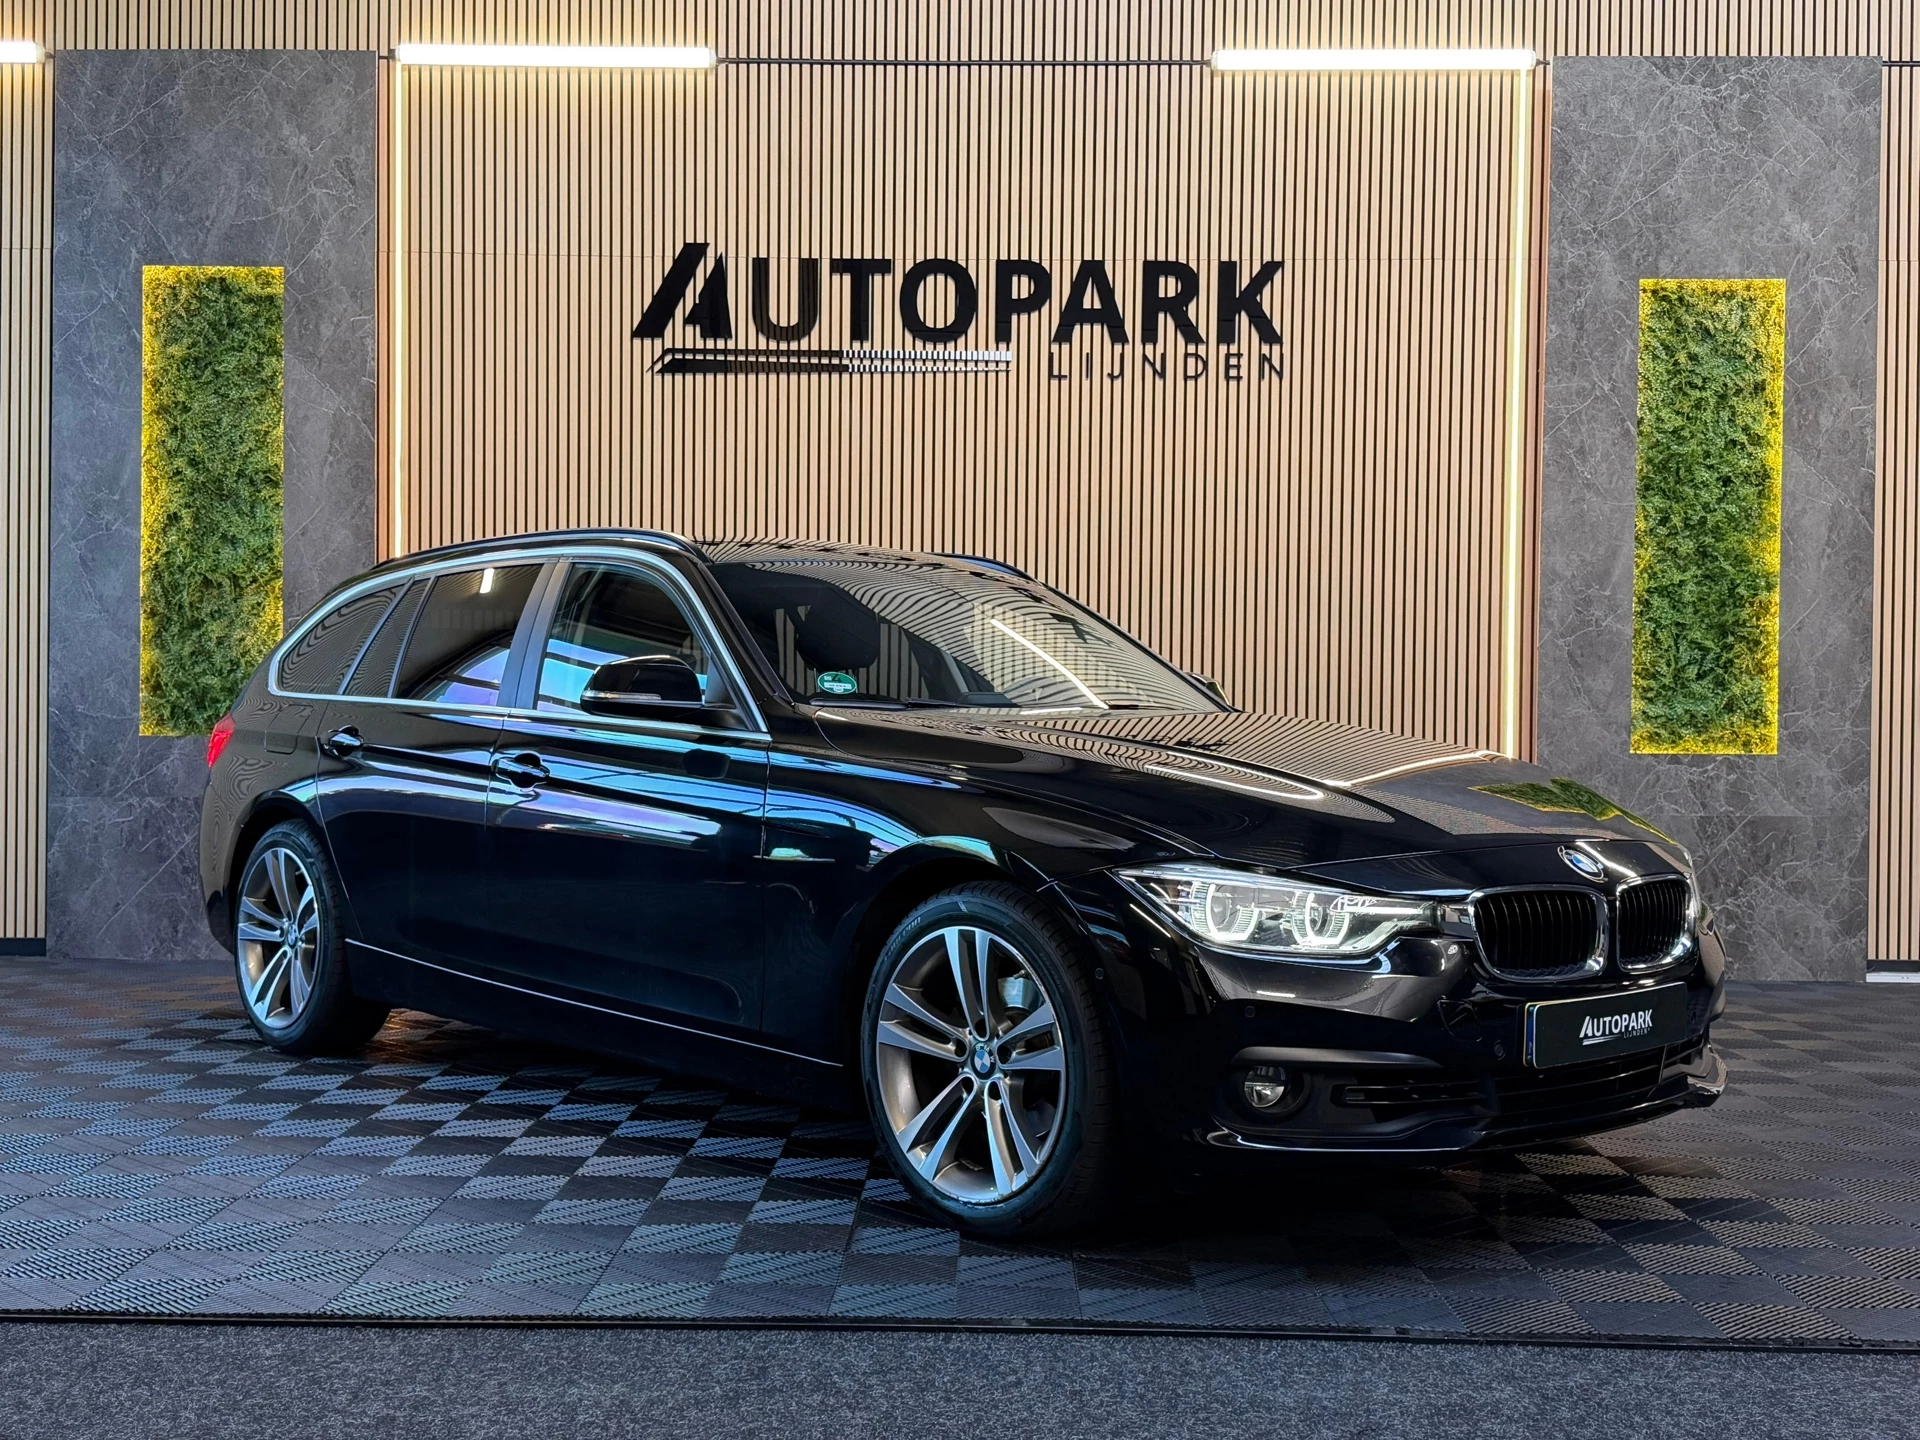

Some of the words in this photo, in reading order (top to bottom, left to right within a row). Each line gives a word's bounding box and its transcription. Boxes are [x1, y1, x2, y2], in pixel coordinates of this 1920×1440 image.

[631, 242, 1284, 345] AUTOPARK
[1049, 351, 1284, 380] LIJNDEN
[1579, 1009, 1653, 1038] AUTOPARK
